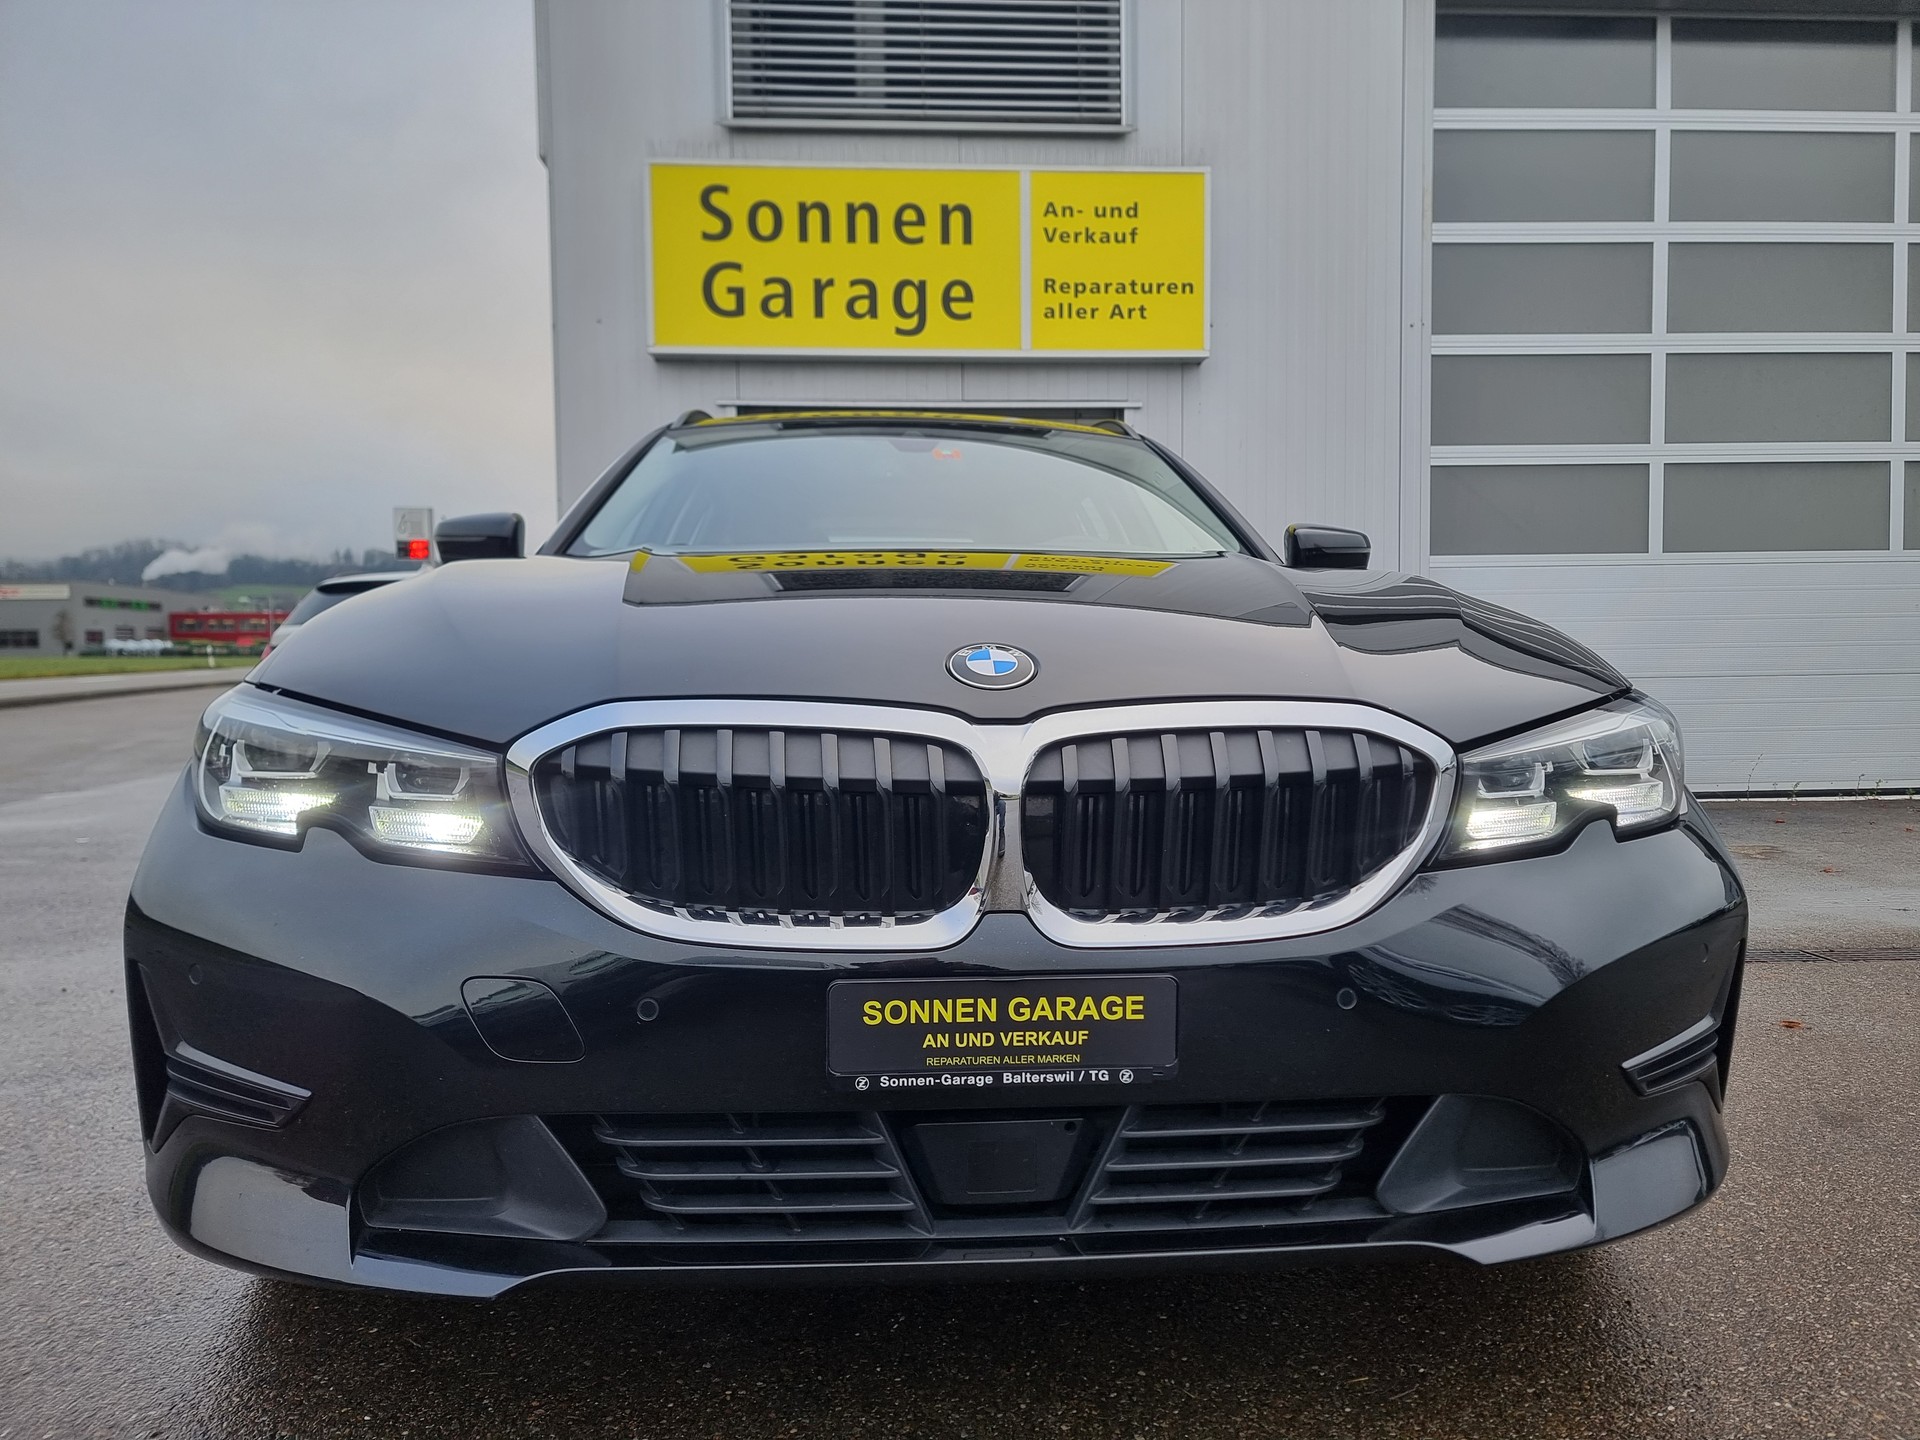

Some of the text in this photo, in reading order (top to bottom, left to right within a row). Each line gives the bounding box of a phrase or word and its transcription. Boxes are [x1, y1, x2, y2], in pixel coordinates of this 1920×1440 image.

[699, 183, 974, 246] Sonnen
[1043, 201, 1139, 219] An- und
[1043, 226, 1139, 245] Verkauf
[1043, 278, 1195, 299] Reparaturen
[701, 261, 975, 337] Garage
[1043, 302, 1147, 320] aller Art
[862, 995, 1145, 1025] SONNEN GARAGE
[922, 1030, 1089, 1049] AN UND VERKAUF
[926, 1053, 1081, 1066] REPARATUREN ALLER MARKEN
[879, 1073, 994, 1087] Sonnen-Garage
[1002, 1070, 1075, 1084] Balterswil
[1078, 1070, 1085, 1082] /
[1088, 1069, 1110, 1082] TG
